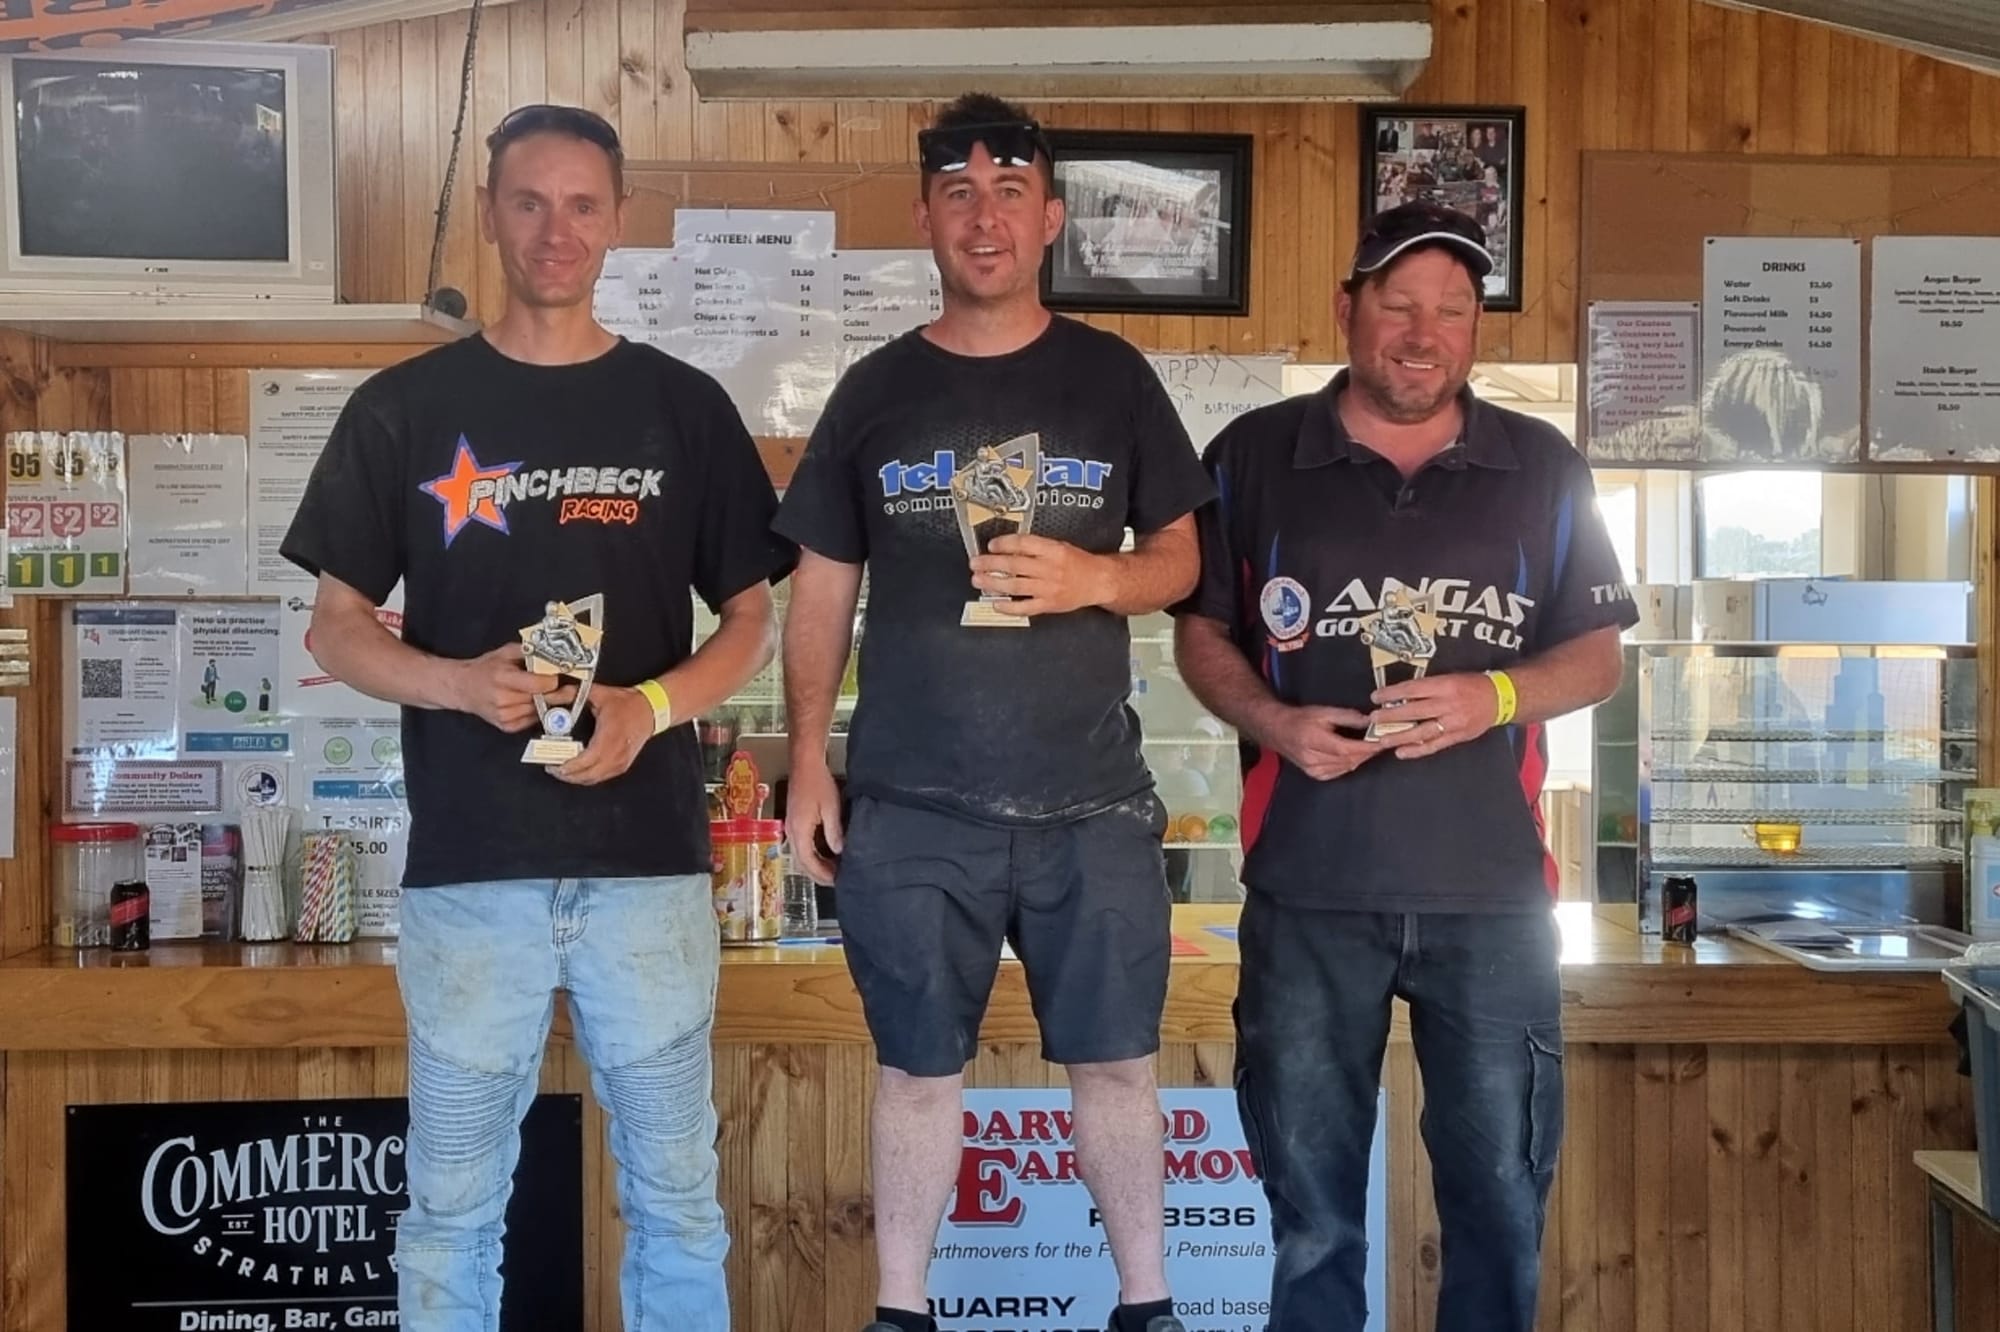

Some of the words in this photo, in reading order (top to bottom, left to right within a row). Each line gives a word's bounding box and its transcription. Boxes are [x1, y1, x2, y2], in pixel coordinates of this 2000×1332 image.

[696, 234, 752, 244] CANTEEN
[756, 235, 792, 244] MENU
[695, 267, 711, 275] Hot
[1762, 262, 1806, 272] DRINKS
[1723, 280, 1751, 288] Water
[1952, 275, 1982, 284] Burger
[1723, 295, 1741, 303] Soft
[1742, 295, 1771, 303] Drinks
[694, 313, 718, 322] Chips
[1723, 309, 1767, 318] Flavoured
[1769, 309, 1789, 318] Milk
[1723, 324, 1766, 332] Powerade
[1723, 339, 1754, 349] Energy
[1755, 339, 1783, 348] Drinks
[1152, 355, 1220, 387] APPY
[1922, 366, 1946, 374] Steak
[1948, 366, 1978, 375] Burger
[10, 452, 40, 477] 95
[467, 466, 664, 517] PINCHBECK
[883, 490, 1104, 515] commtions
[560, 499, 639, 524] RACING
[10, 507, 42, 535] $2
[53, 506, 82, 533] $2
[93, 504, 116, 525] $2
[16, 556, 32, 584] 1
[57, 556, 74, 584] 1
[98, 556, 109, 574] 1
[1325, 577, 1536, 627] ANGAS
[193, 617, 214, 625] Help
[193, 627, 230, 636] physical
[113, 771, 166, 782] ommunity
[169, 771, 203, 780] Dollars
[323, 816, 332, 827] T
[349, 816, 402, 829] SHIRTS
[376, 889, 400, 898] SIZES
[303, 1116, 342, 1127] THE
[141, 1132, 406, 1235] COMMERC
[948, 1147, 1260, 1223] EARMOV
[228, 1220, 249, 1230] EST
[263, 1204, 376, 1253] HOTEL
[931, 1242, 1029, 1260] arthmovers
[1034, 1242, 1060, 1259] for
[1064, 1242, 1092, 1259] the
[1178, 1242, 1266, 1259] Peninsula
[927, 1297, 1076, 1318] UARRY
[180, 1310, 277, 1332] Dining,
[285, 1308, 337, 1329] Bar,
[344, 1306, 400, 1327] Gam
